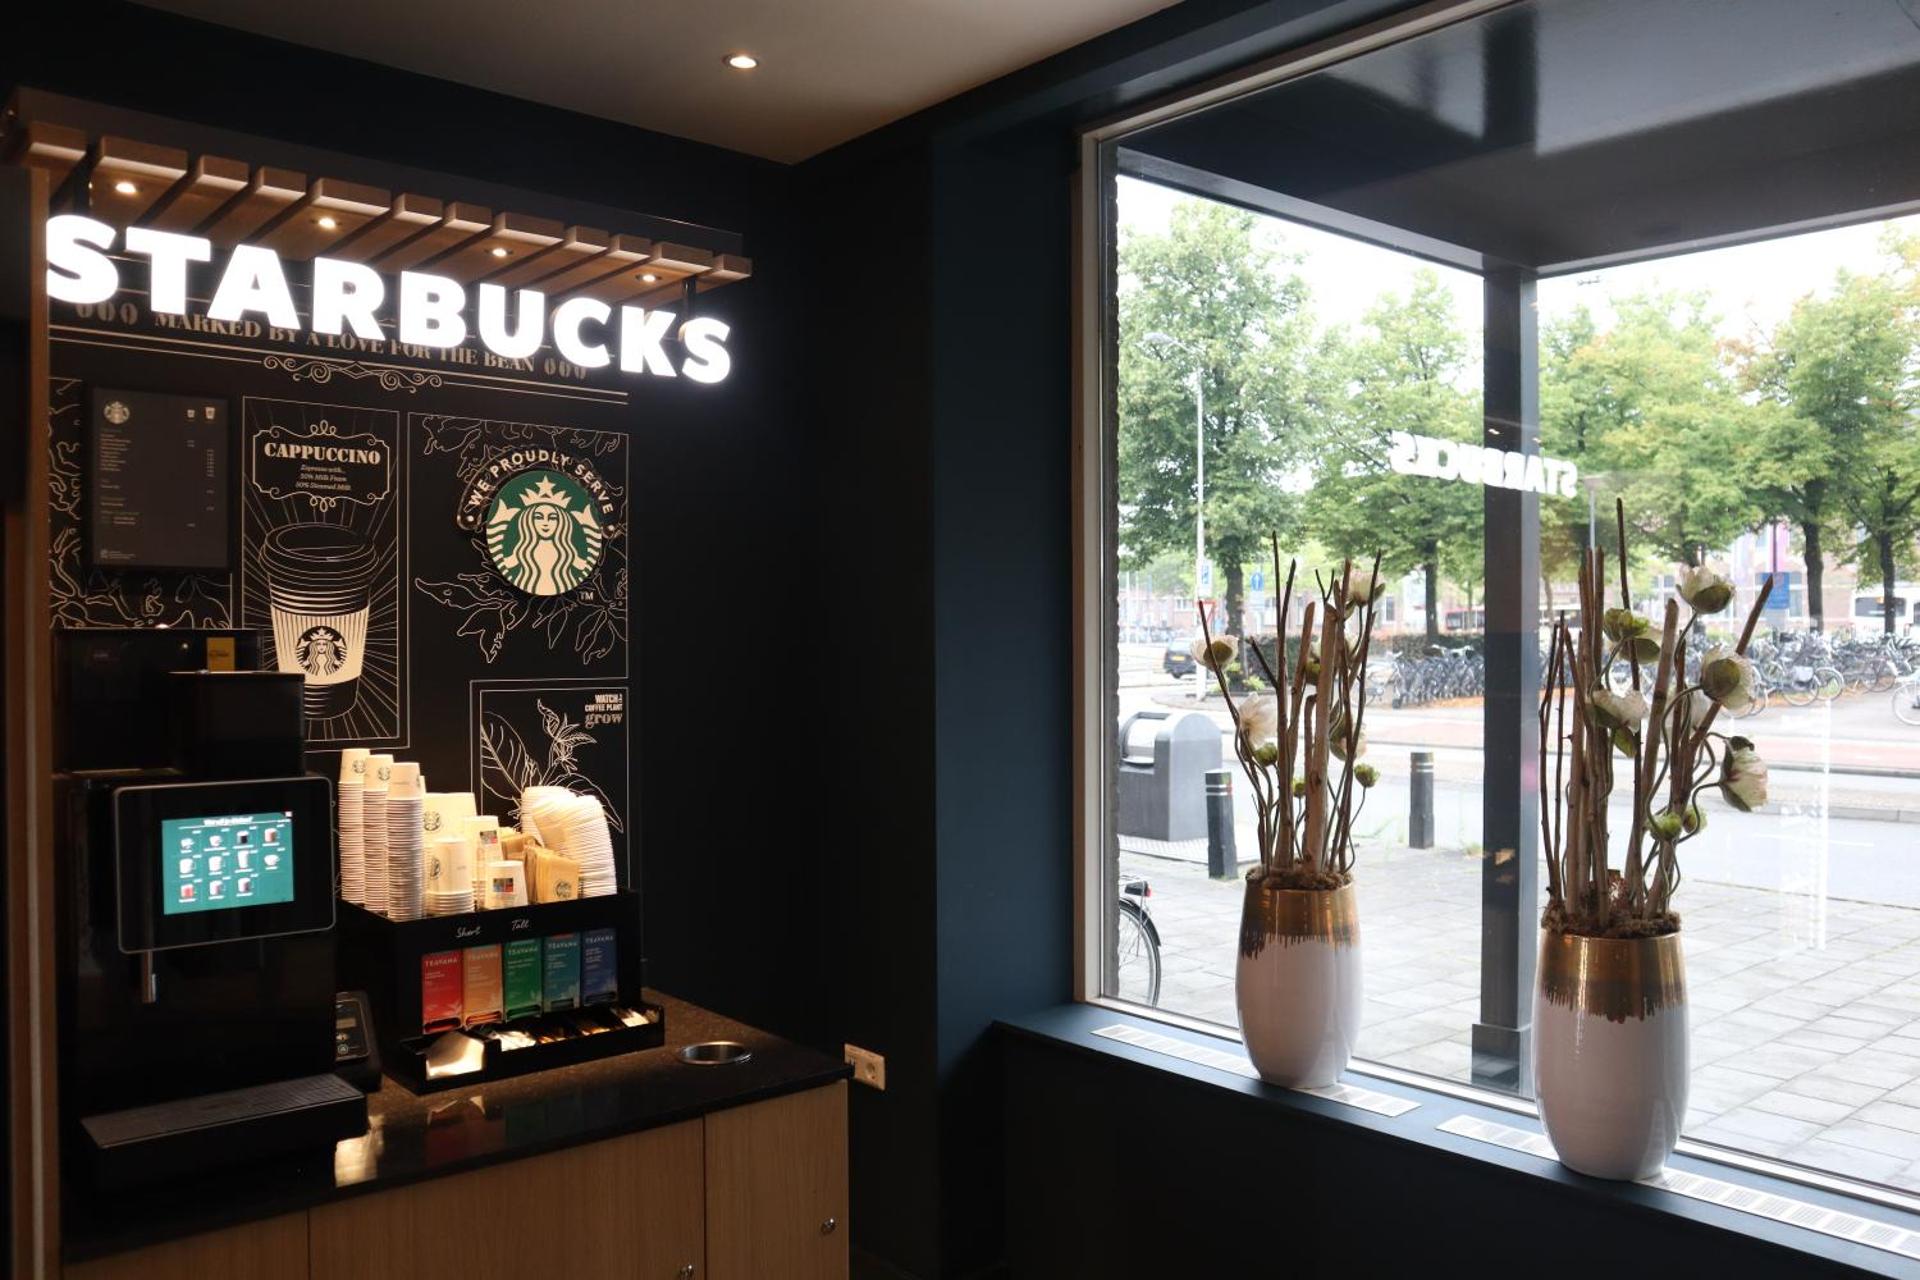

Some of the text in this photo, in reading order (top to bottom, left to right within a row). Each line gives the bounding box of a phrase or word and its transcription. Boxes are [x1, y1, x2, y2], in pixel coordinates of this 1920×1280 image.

[46, 213, 733, 386] STARBUCKS
[155, 313, 261, 337] MARKED
[269, 327, 297, 343] BY
[306, 332, 320, 347] A
[327, 334, 384, 355] LOVE
[390, 340, 431, 360] FOR
[484, 352, 533, 372] BEAN
[264, 442, 381, 465] CAPPUCCINO
[466, 450, 614, 515] WE PROUDLY SERVE
[594, 694, 618, 703] WATCH
[585, 704, 605, 712] COFFEE
[585, 713, 622, 729] grow
[456, 926, 481, 938] Short
[511, 919, 530, 931] Tall
